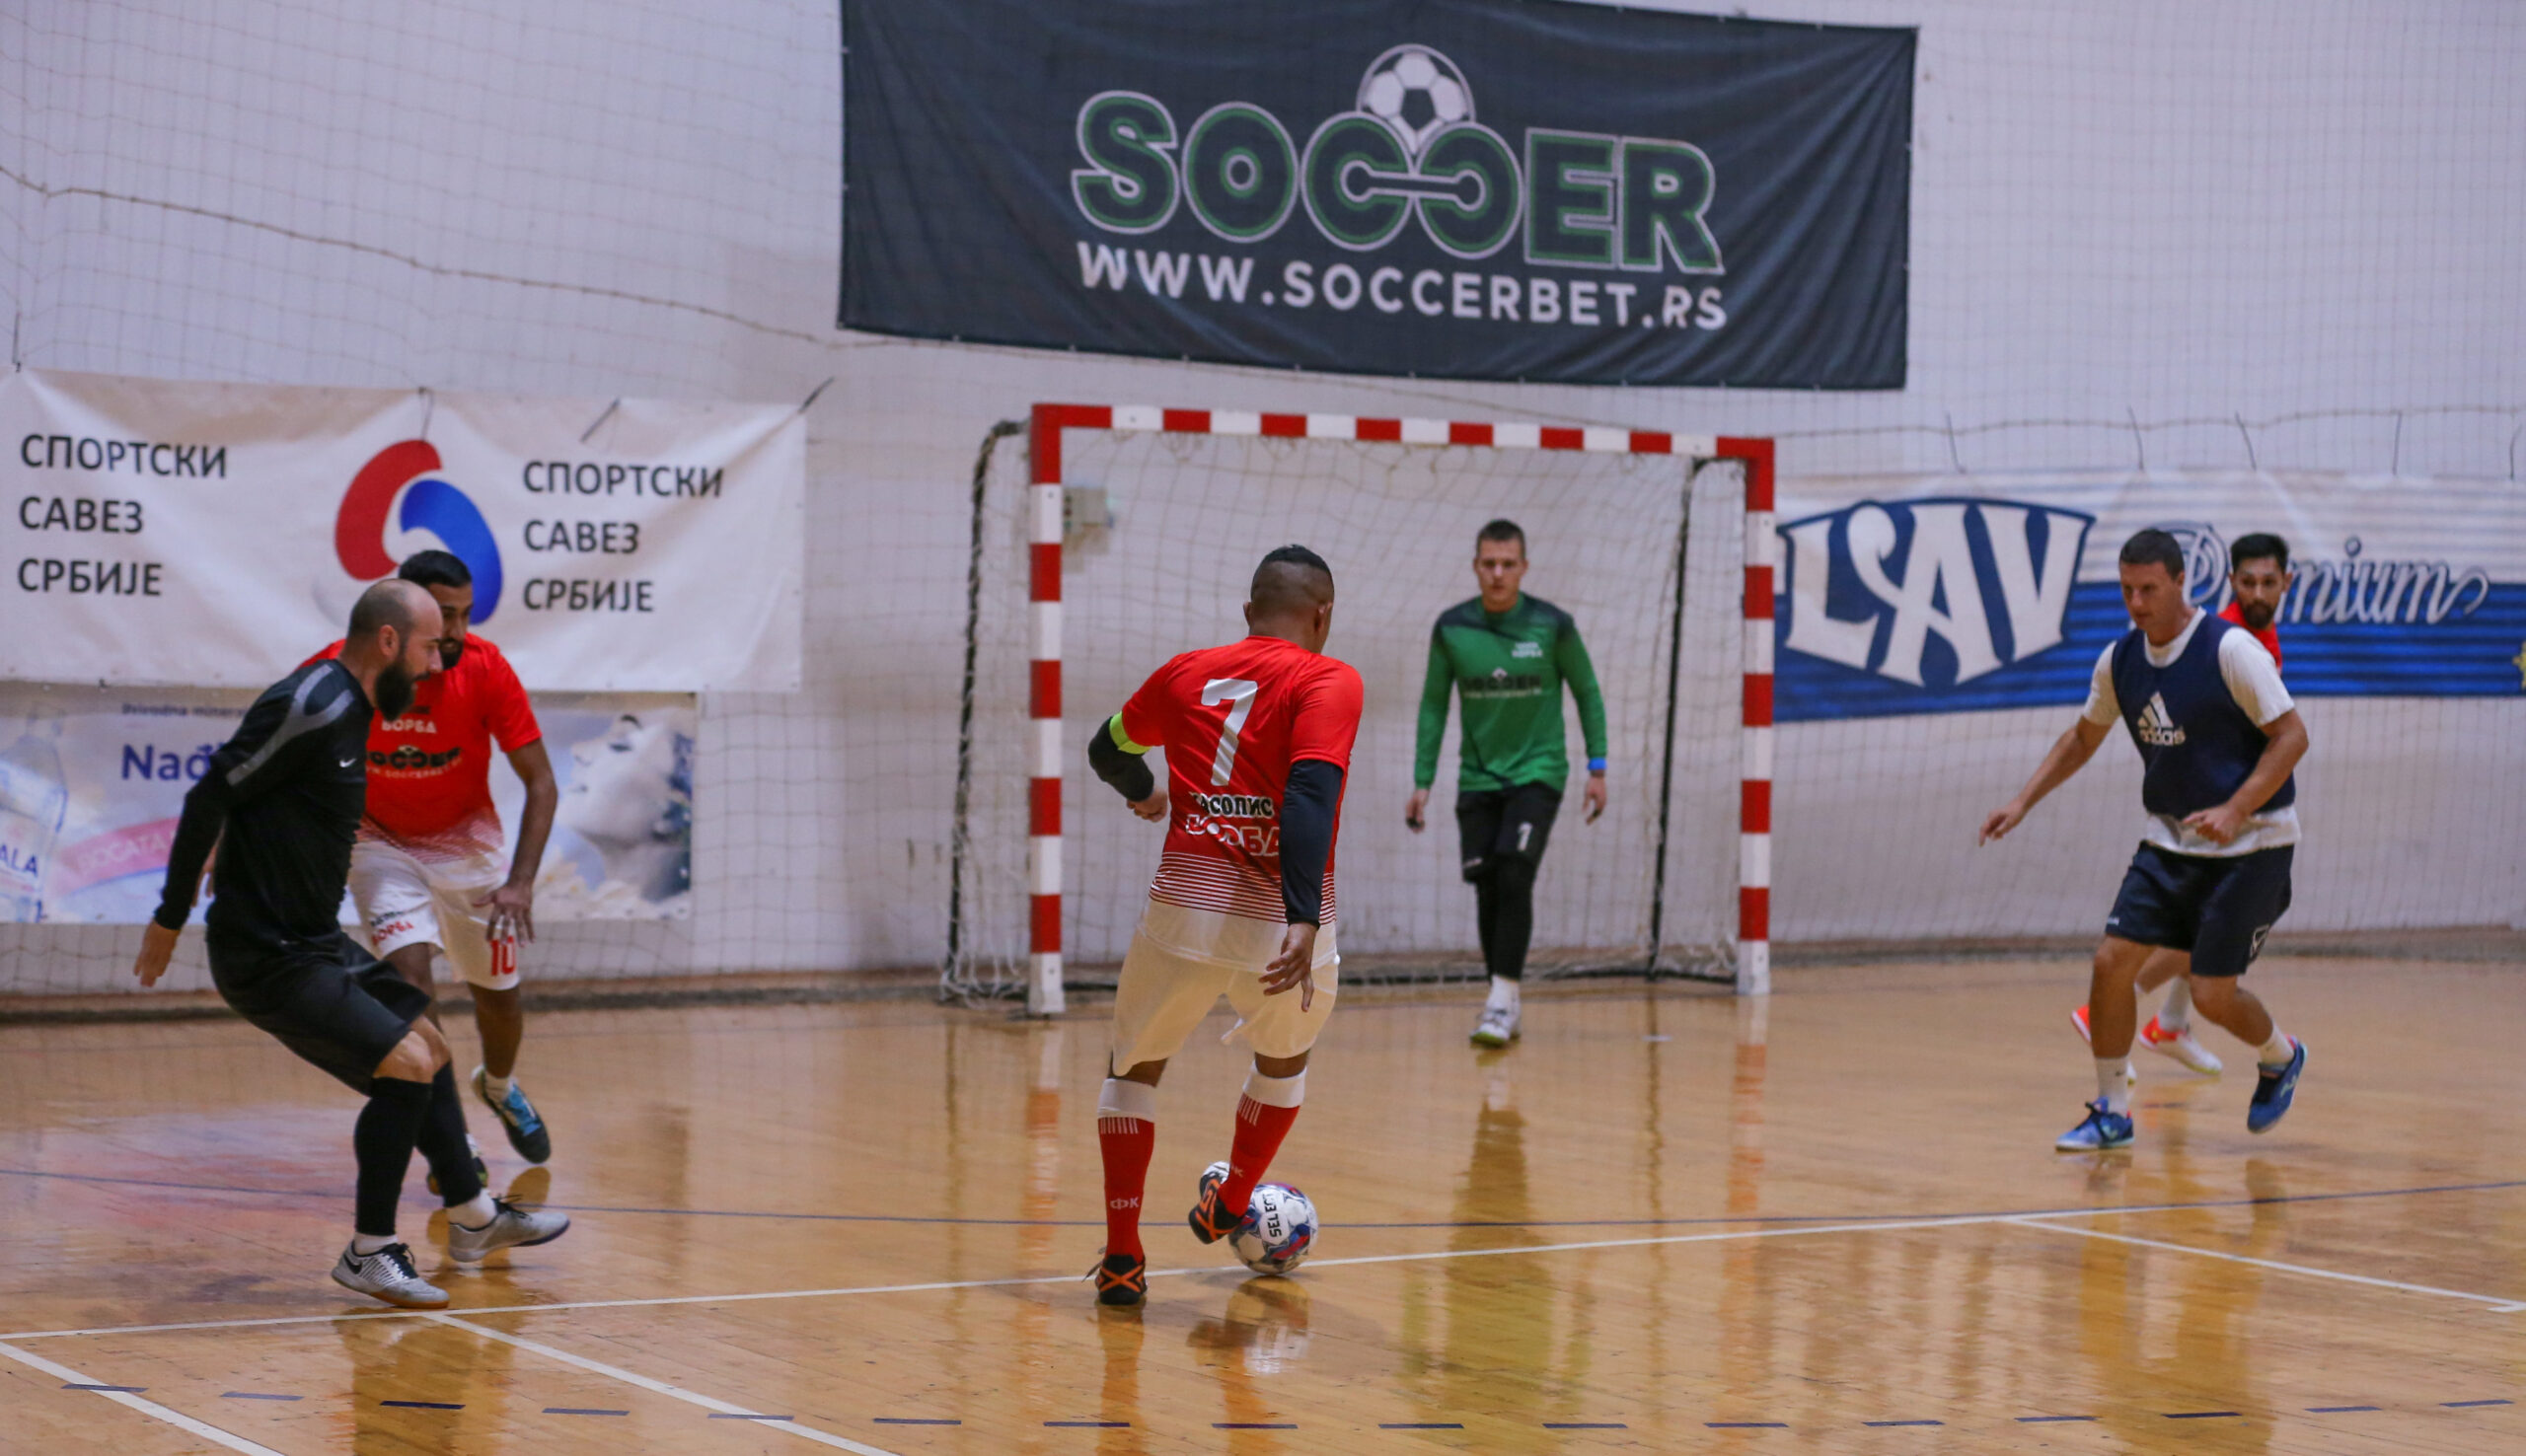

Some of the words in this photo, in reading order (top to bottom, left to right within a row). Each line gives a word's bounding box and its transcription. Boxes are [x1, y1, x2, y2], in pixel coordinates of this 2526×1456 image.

[1072, 90, 1726, 274] SOCCER
[1077, 241, 1728, 331] WWW.SOCCERBET.RS
[20, 434, 227, 478] СПОРТСКИ
[523, 461, 725, 498] СПОРТСКИ
[19, 496, 144, 535] САВЕЗ
[523, 519, 640, 554] САВЕЗ
[17, 558, 163, 597] СРБИЈЕ
[2129, 520, 2489, 625] Pmium
[523, 578, 655, 613] СРБИЈЕ
[1784, 500, 2085, 688] LAV
[1200, 678, 1259, 787] 7
[121, 743, 226, 781] Nađ
[1189, 791, 1275, 819] АСОПИС
[1517, 822, 1533, 851] 1
[489, 935, 517, 977] 10
